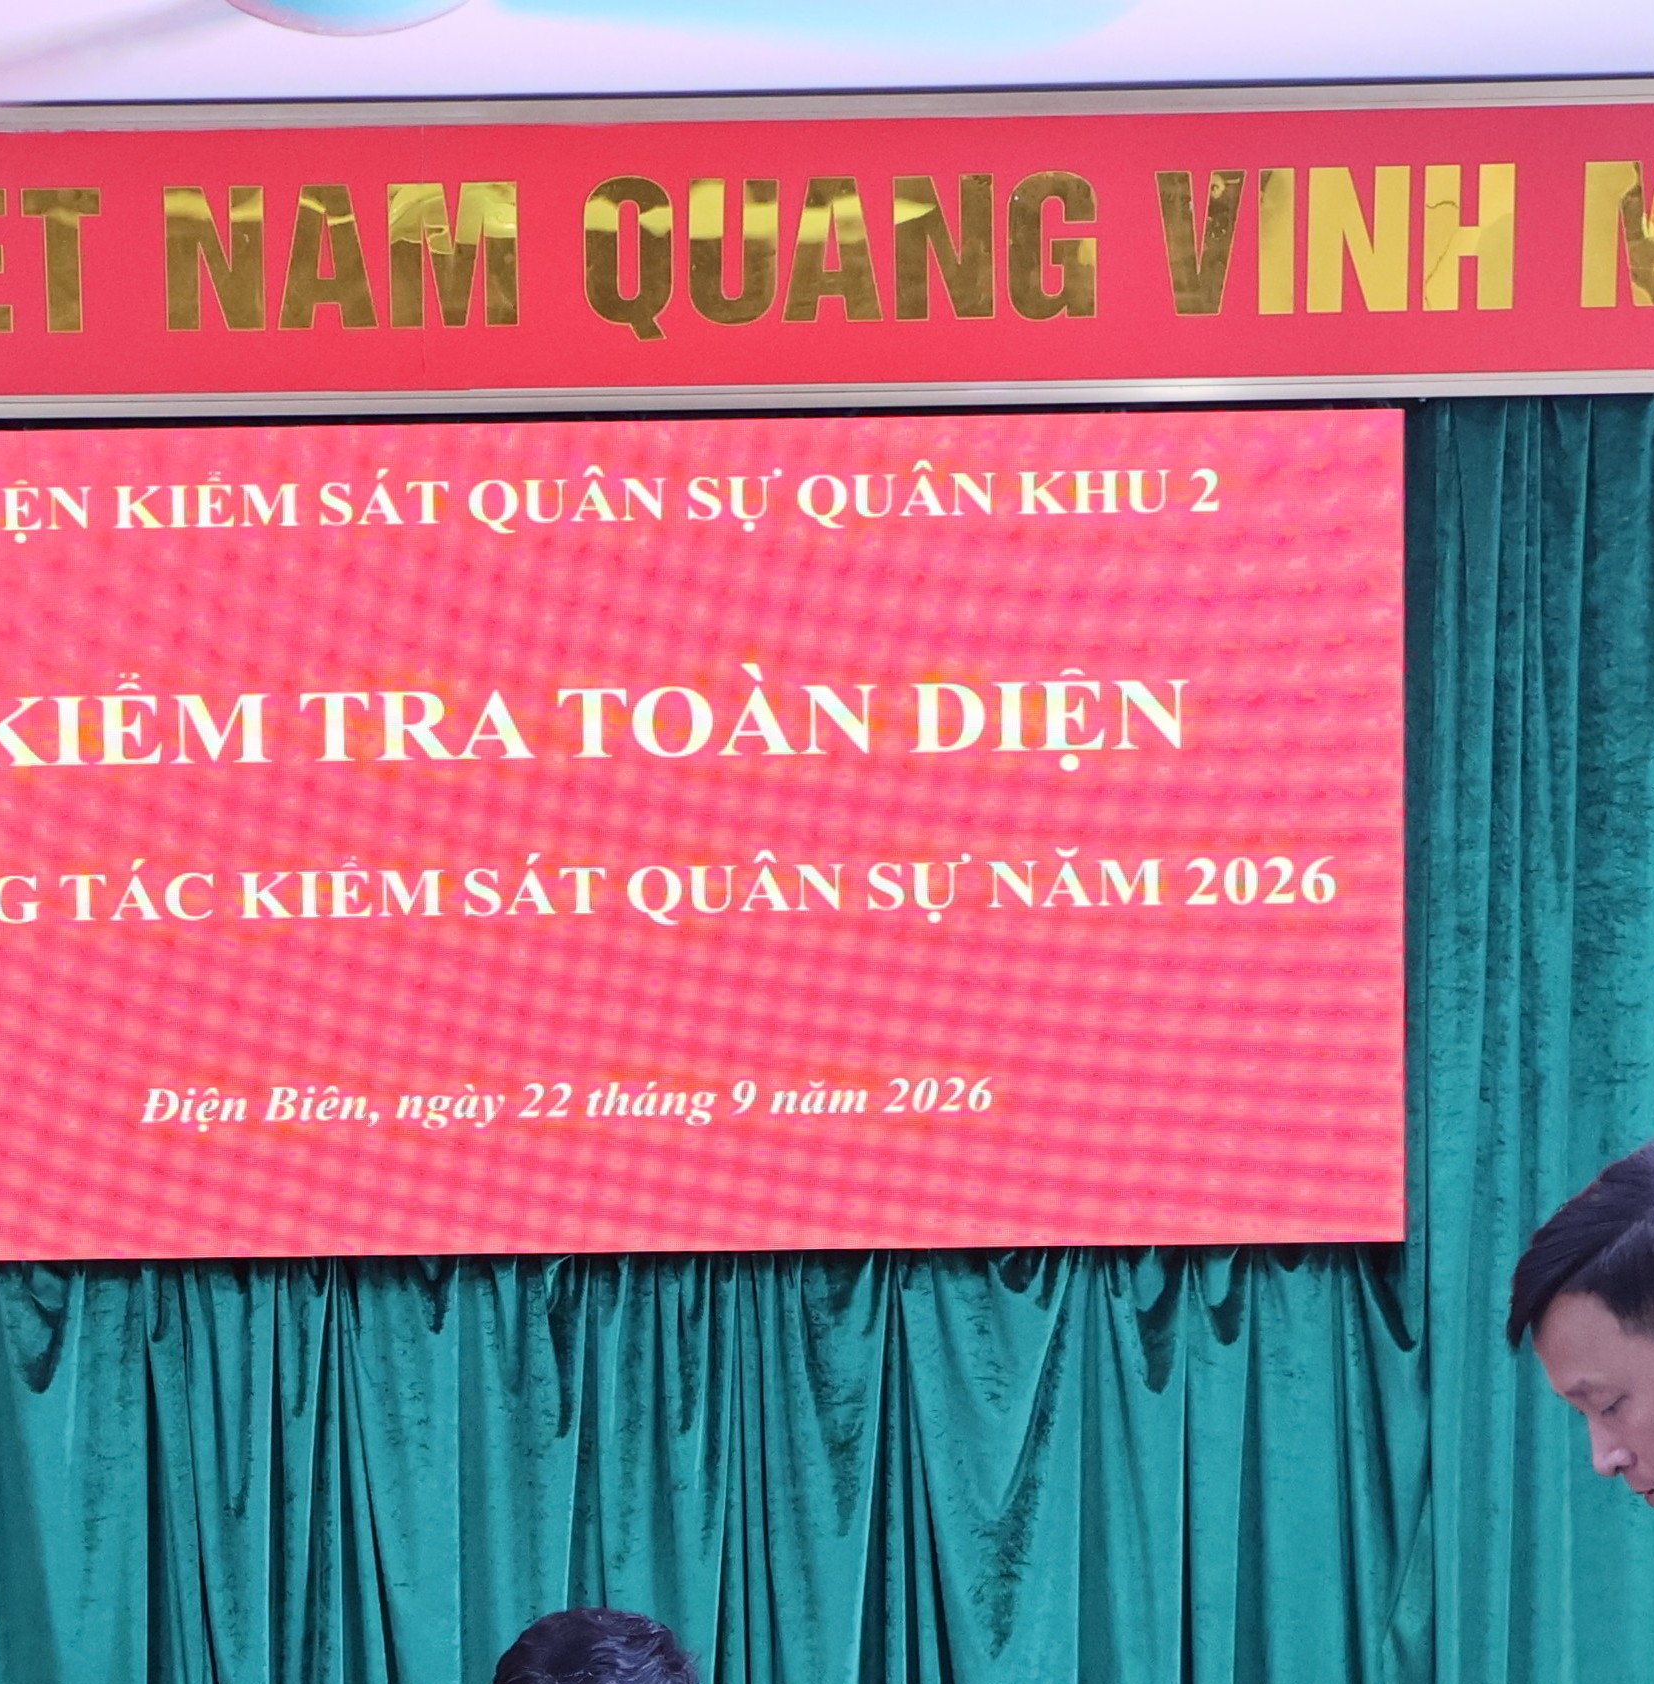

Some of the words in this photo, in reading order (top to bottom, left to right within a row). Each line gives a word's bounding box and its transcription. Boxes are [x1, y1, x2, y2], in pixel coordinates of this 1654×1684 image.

[162, 181, 520, 333] NAM
[582, 170, 1100, 341] QUANG
[1153, 162, 1517, 319] VINH
[115, 470, 299, 529] KIỂM
[320, 468, 449, 526] SÁT
[468, 465, 666, 534] QUÂN
[687, 468, 783, 532] SỰ
[797, 459, 996, 529] QUÂN
[1018, 468, 1170, 515] KHU
[1189, 467, 1221, 512] 2
[299, 689, 536, 762] TRA
[557, 662, 876, 759] TOÀN
[910, 667, 1190, 772] DIỆN
[60, 858, 215, 921] TÁC
[240, 857, 445, 919] KIỂM
[463, 852, 606, 918] SÁT
[626, 849, 844, 925] QUÂN
[866, 852, 972, 924] SỰ
[987, 847, 1163, 909] NĂM
[1185, 855, 1337, 905] 2026
[141, 1087, 248, 1133] Điện
[264, 1085, 381, 1127] Biên,
[395, 1083, 507, 1130] ngày
[517, 1081, 573, 1119] 22
[586, 1080, 718, 1126] tháng
[731, 1079, 758, 1115] 9
[770, 1080, 869, 1116] năm
[882, 1077, 994, 1114] 2026
